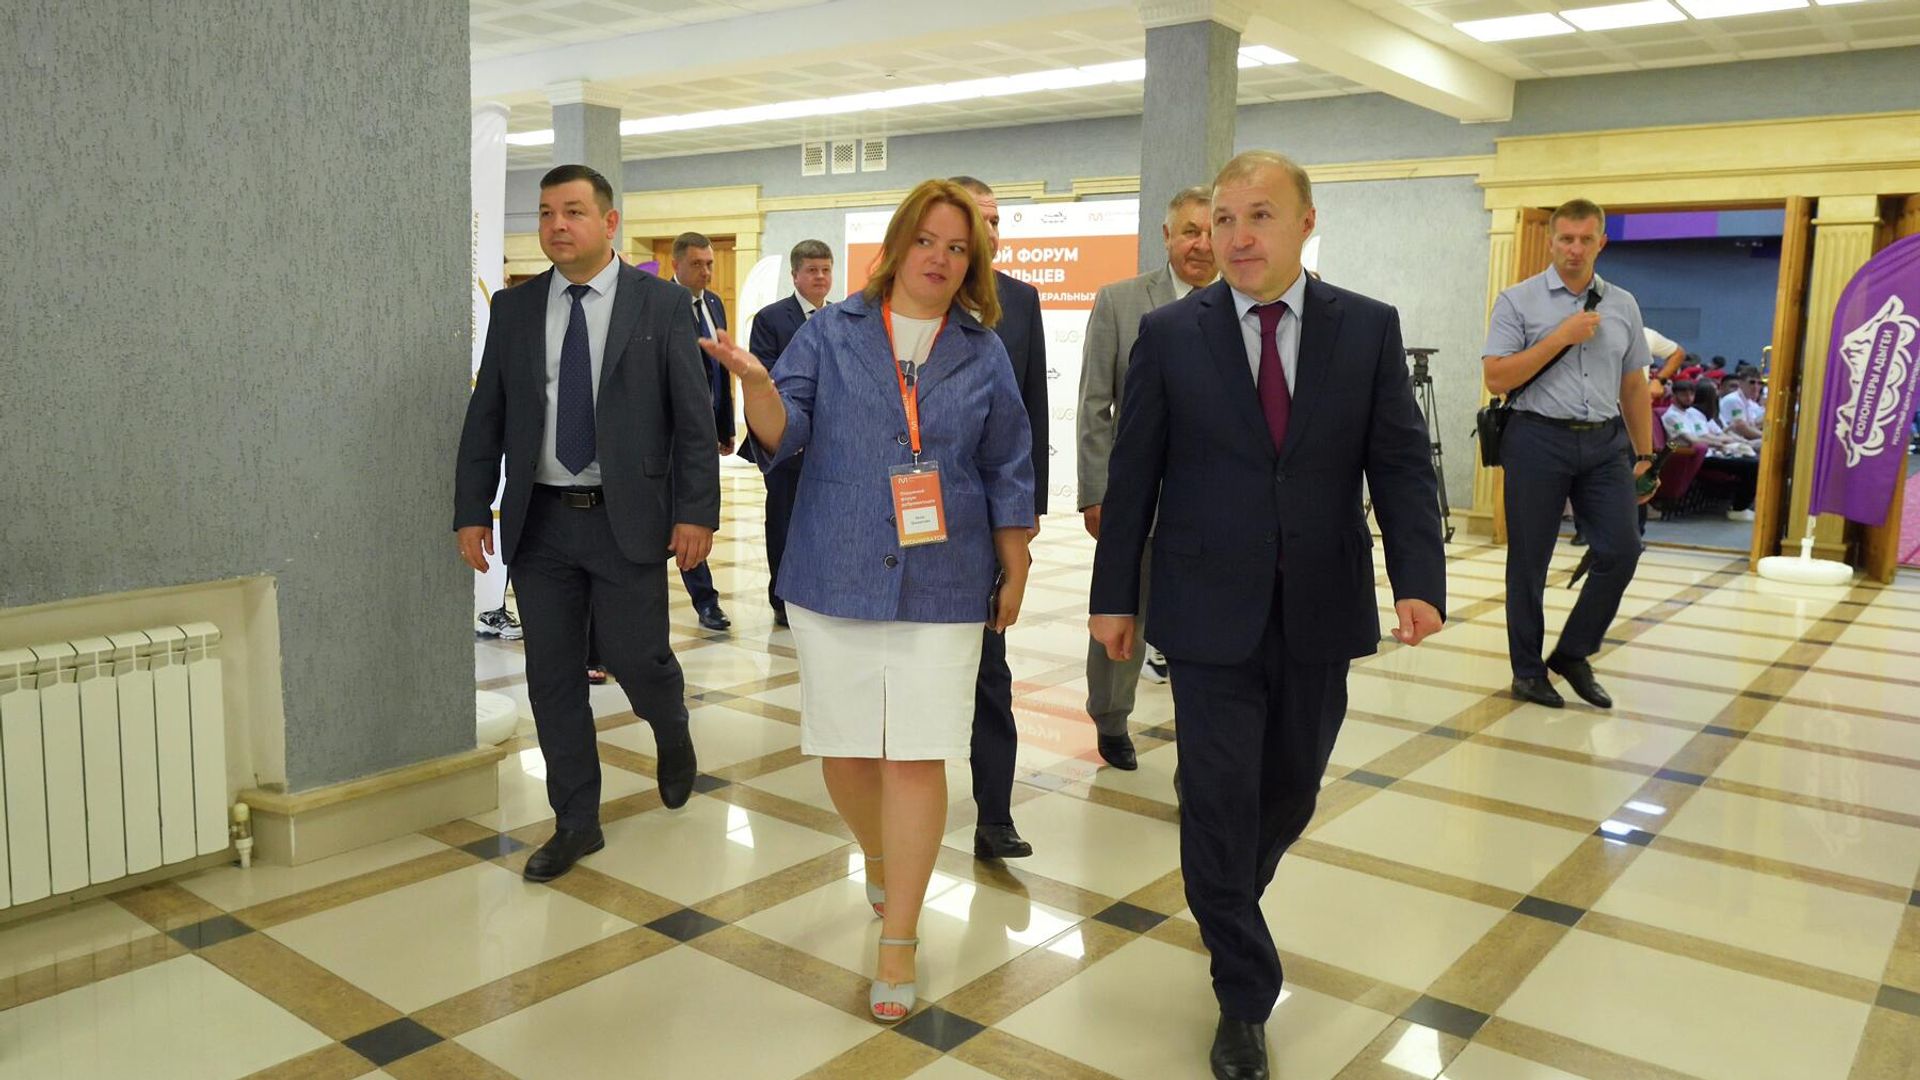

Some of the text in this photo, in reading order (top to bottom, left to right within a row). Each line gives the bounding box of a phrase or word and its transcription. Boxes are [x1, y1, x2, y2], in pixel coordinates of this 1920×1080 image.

[1017, 247, 1078, 262] ФОРУМ
[1000, 268, 1066, 285] ОЛЬЦЕВ
[1855, 331, 1893, 438] ВОЛОНТЕРЫ АДЫГЕИ
